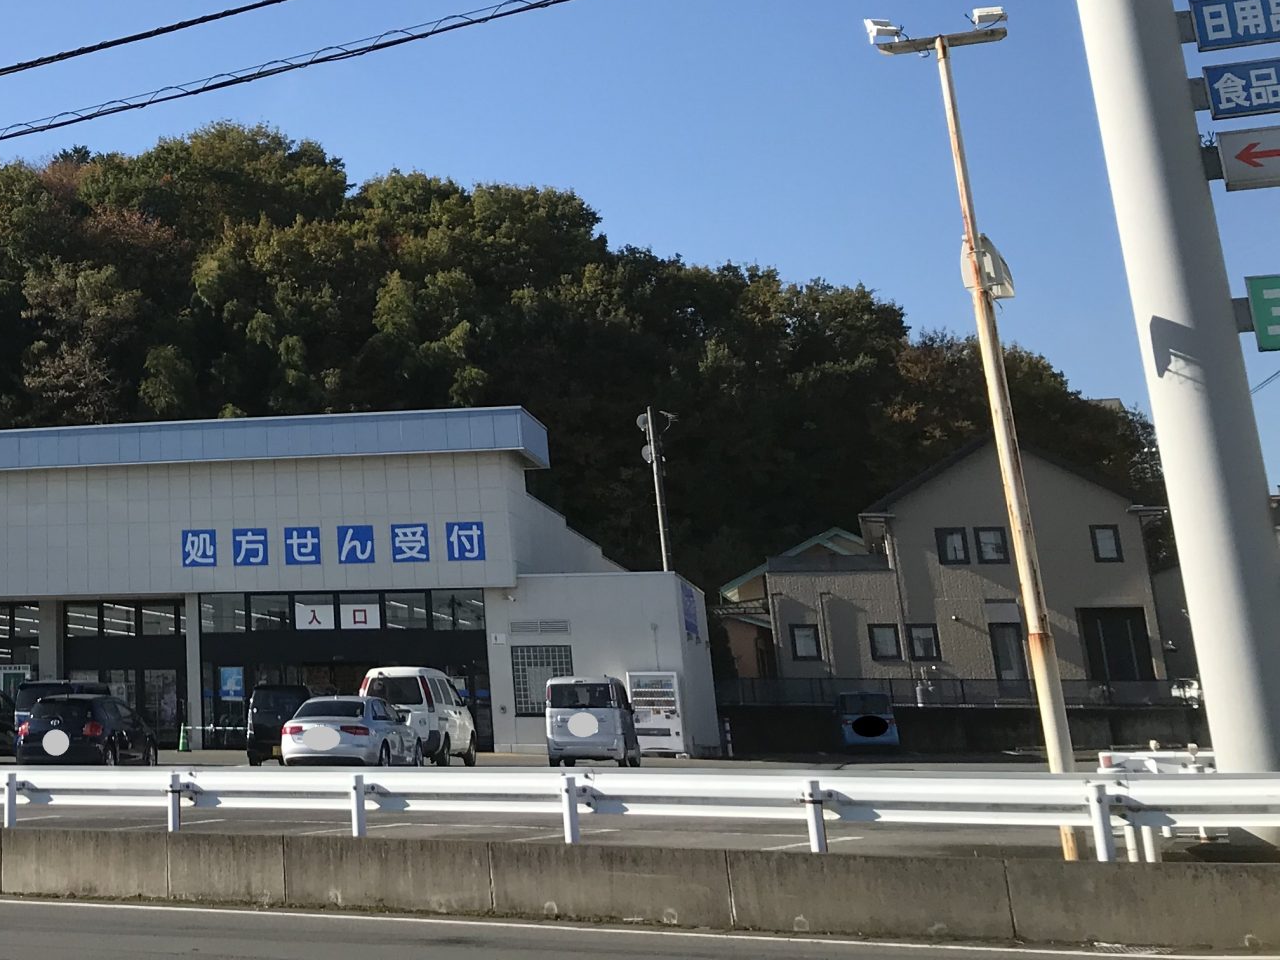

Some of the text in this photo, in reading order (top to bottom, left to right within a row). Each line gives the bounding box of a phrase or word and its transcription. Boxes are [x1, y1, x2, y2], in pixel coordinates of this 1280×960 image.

[1213, 67, 1280, 110] 食品
[184, 524, 481, 565] 処方せん受付
[308, 609, 367, 625] 入口
